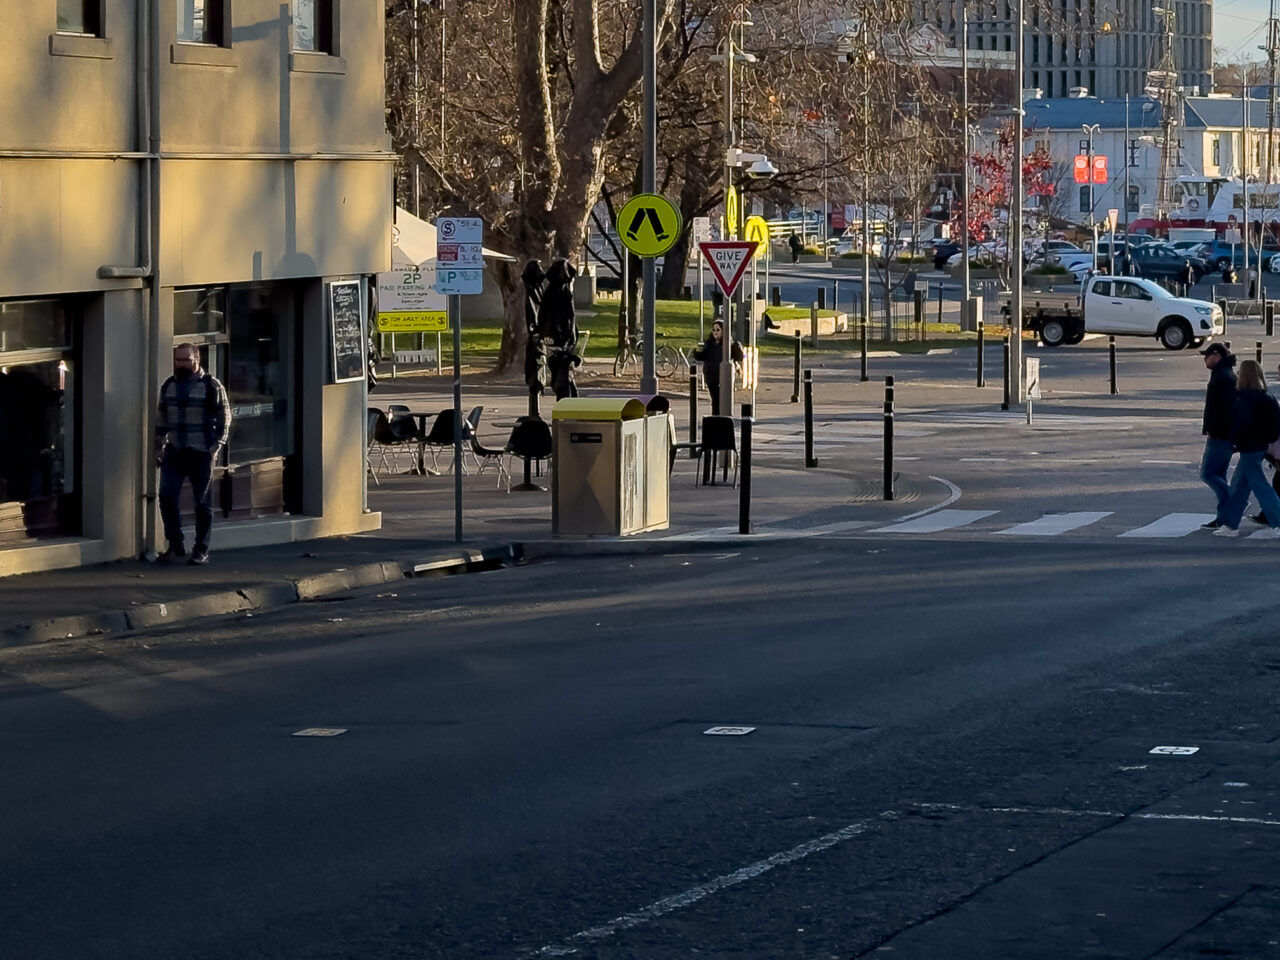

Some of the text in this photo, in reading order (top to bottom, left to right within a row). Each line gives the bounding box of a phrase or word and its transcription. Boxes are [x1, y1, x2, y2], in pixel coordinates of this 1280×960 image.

[716, 251, 742, 261] GIVE
[720, 262, 738, 271] WAY
[403, 273, 422, 285] 2P
